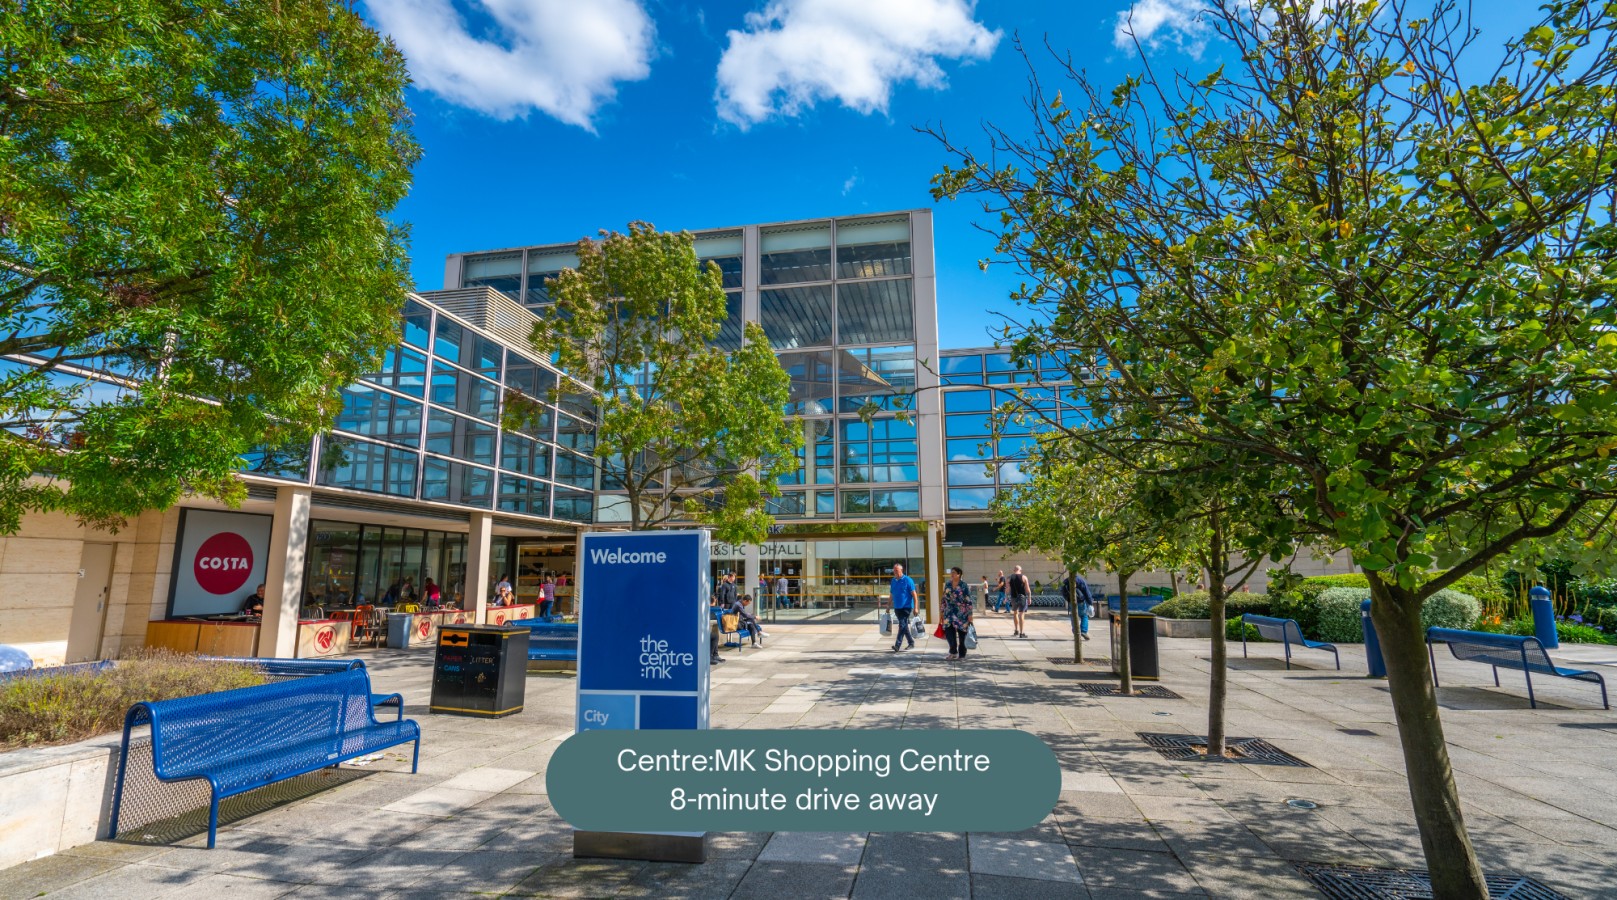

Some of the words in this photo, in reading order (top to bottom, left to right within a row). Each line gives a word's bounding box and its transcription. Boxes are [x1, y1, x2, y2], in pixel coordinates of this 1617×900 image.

[590, 547, 667, 565] Welcome
[710, 544, 729, 556] &S
[732, 544, 802, 556] FODHALL
[199, 556, 249, 571] COSTA
[639, 634, 669, 652] the
[471, 656, 494, 664] LITTER
[639, 650, 694, 666] centre
[443, 664, 460, 672] CANS
[640, 661, 672, 679] :mk
[584, 709, 609, 726] City
